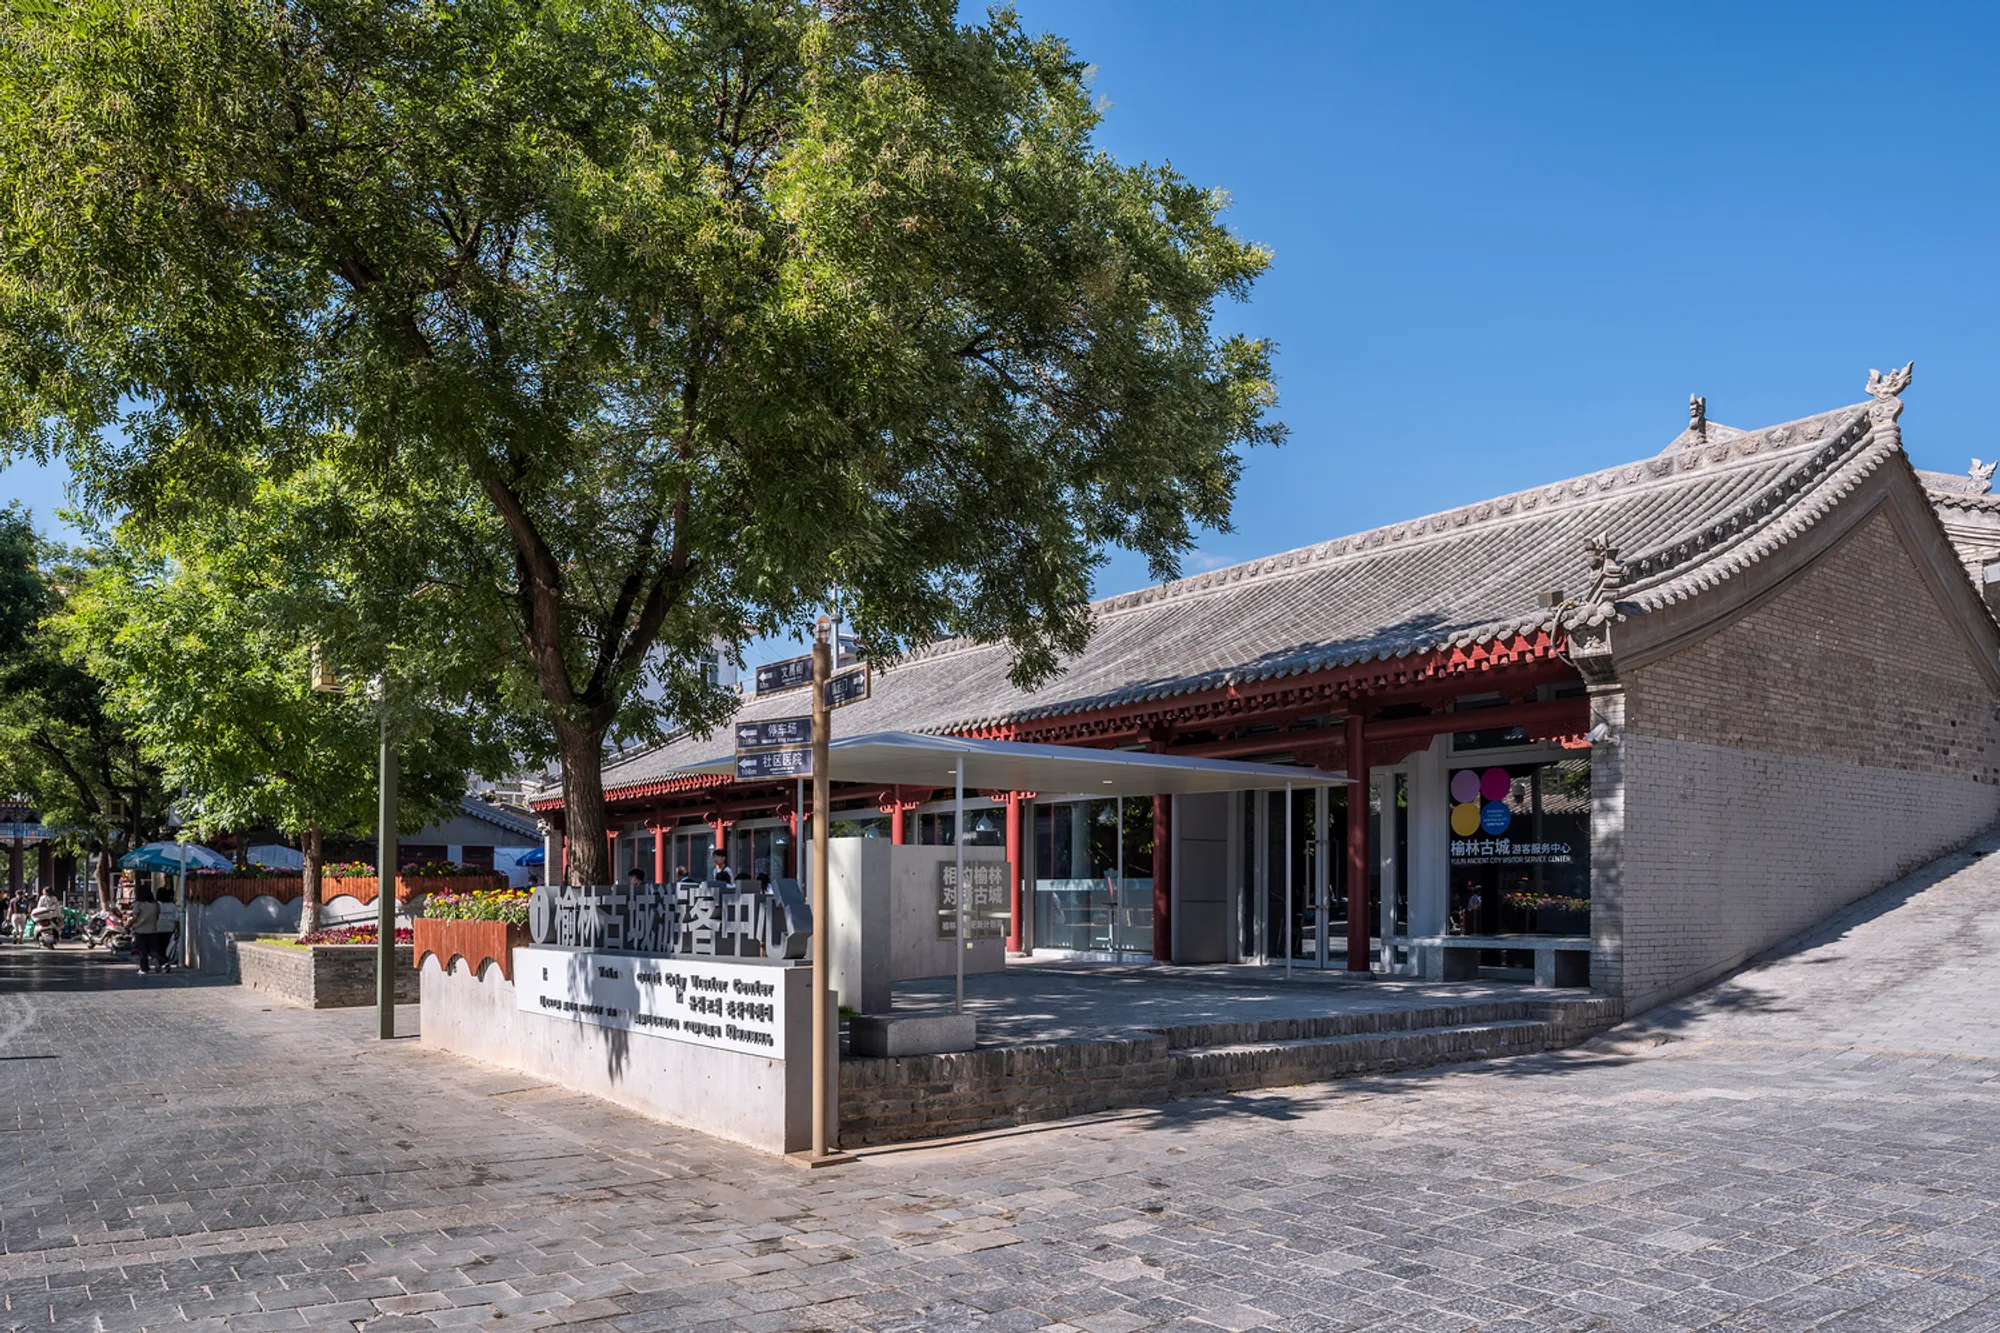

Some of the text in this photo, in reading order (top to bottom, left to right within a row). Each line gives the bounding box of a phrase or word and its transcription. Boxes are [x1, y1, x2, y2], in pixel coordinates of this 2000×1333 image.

[767, 722, 797, 737] 停车场
[763, 752, 803, 768] 社区医院
[1451, 838, 1571, 857] 榆林古城 游客服务中心
[554, 879, 813, 960] 榆林古城游客中心
[665, 972, 688, 992] City
[691, 975, 729, 993] Visitor
[733, 979, 774, 998] Center
